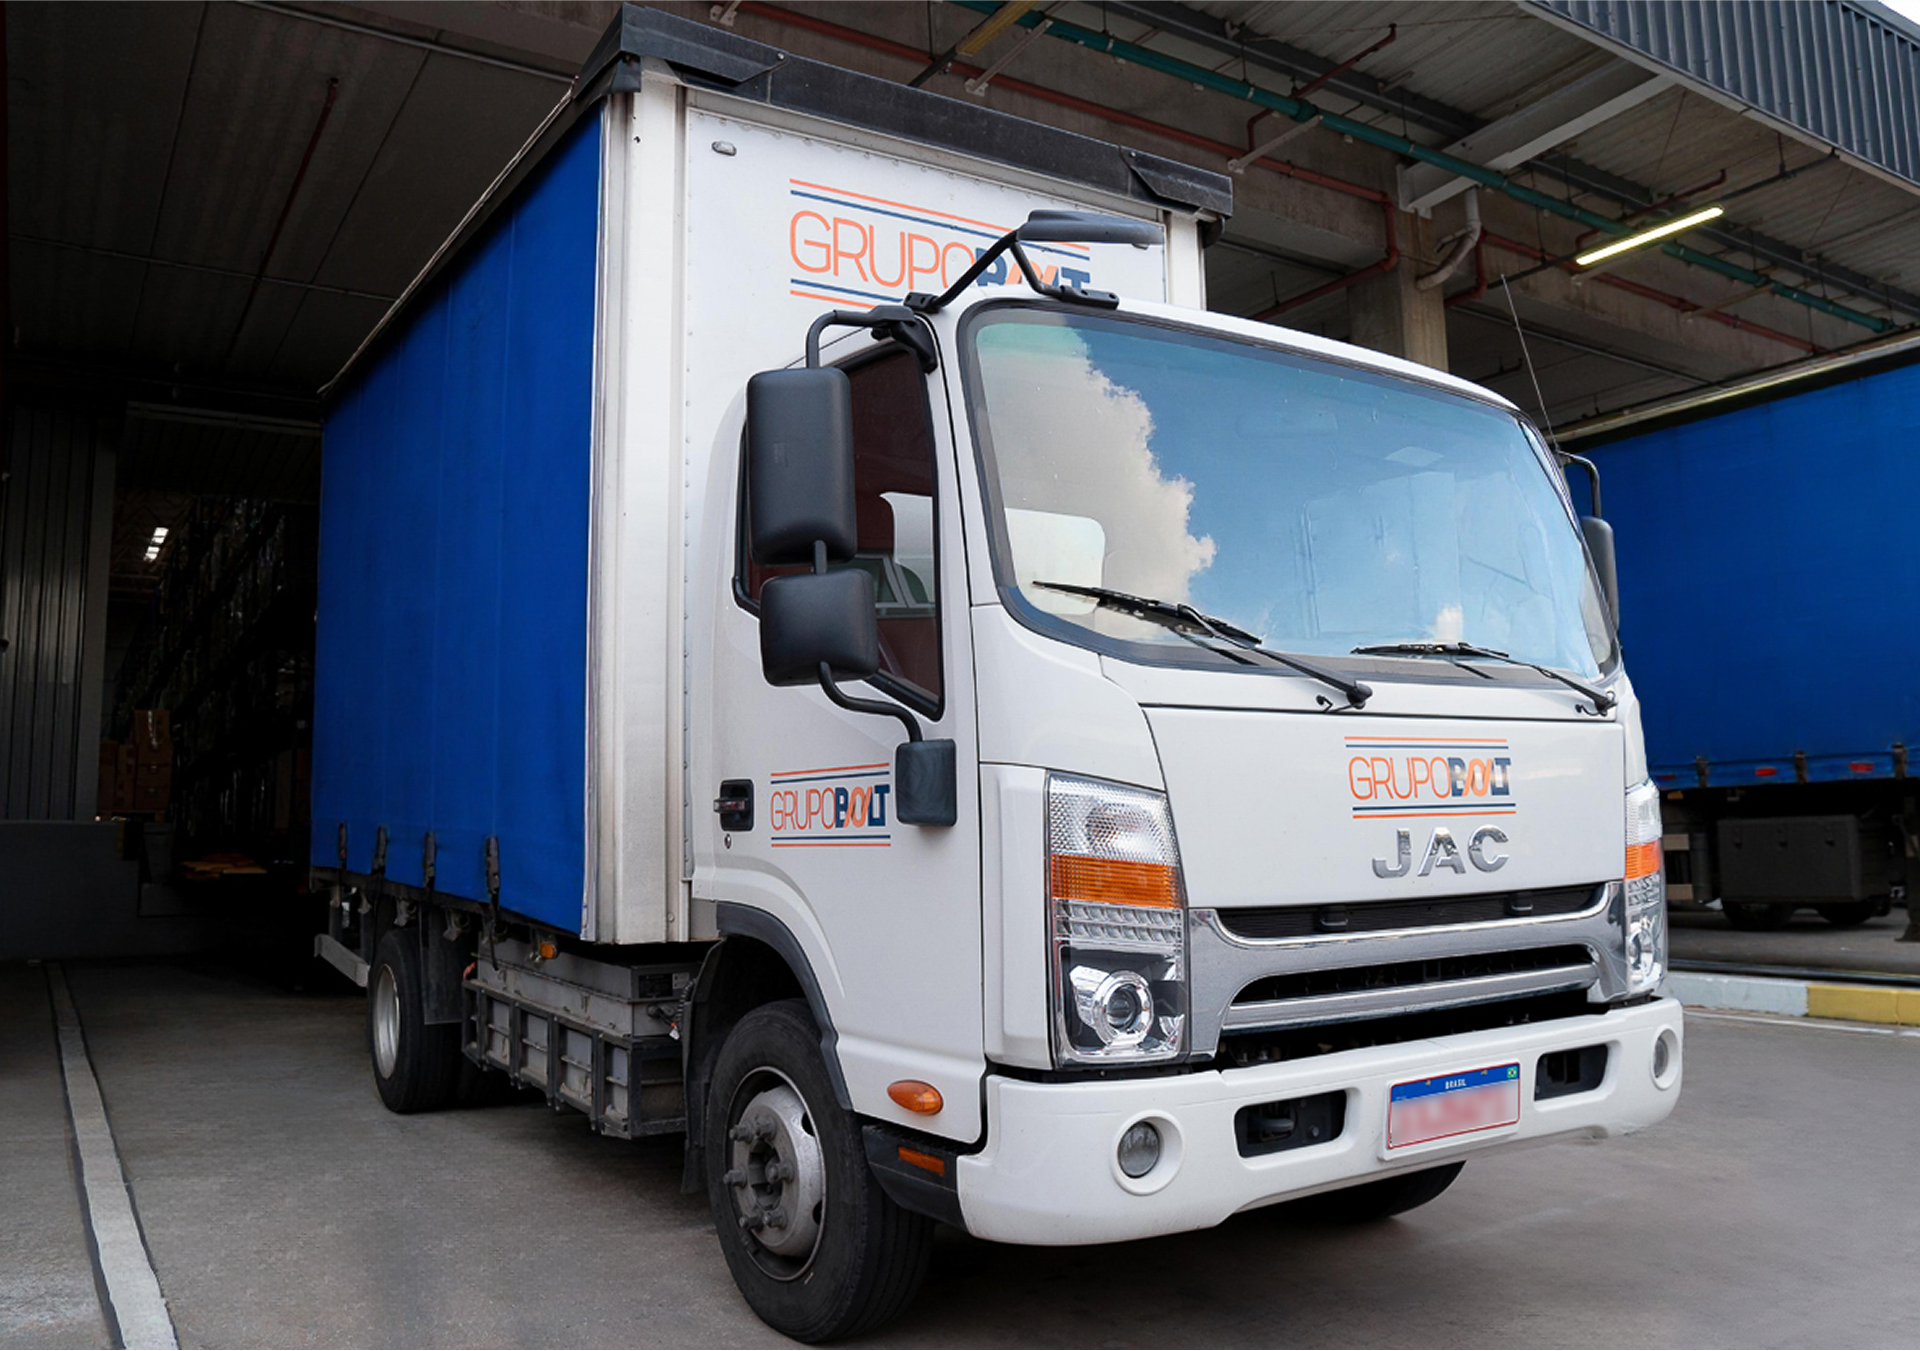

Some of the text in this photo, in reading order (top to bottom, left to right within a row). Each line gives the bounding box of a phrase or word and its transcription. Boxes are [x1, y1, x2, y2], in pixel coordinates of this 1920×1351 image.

[1348, 756, 1511, 800] GRUPOBOLT
[770, 784, 890, 831] GRUPOBOLT
[1372, 824, 1509, 879] JAC
[1445, 1078, 1467, 1089] BRASIL
